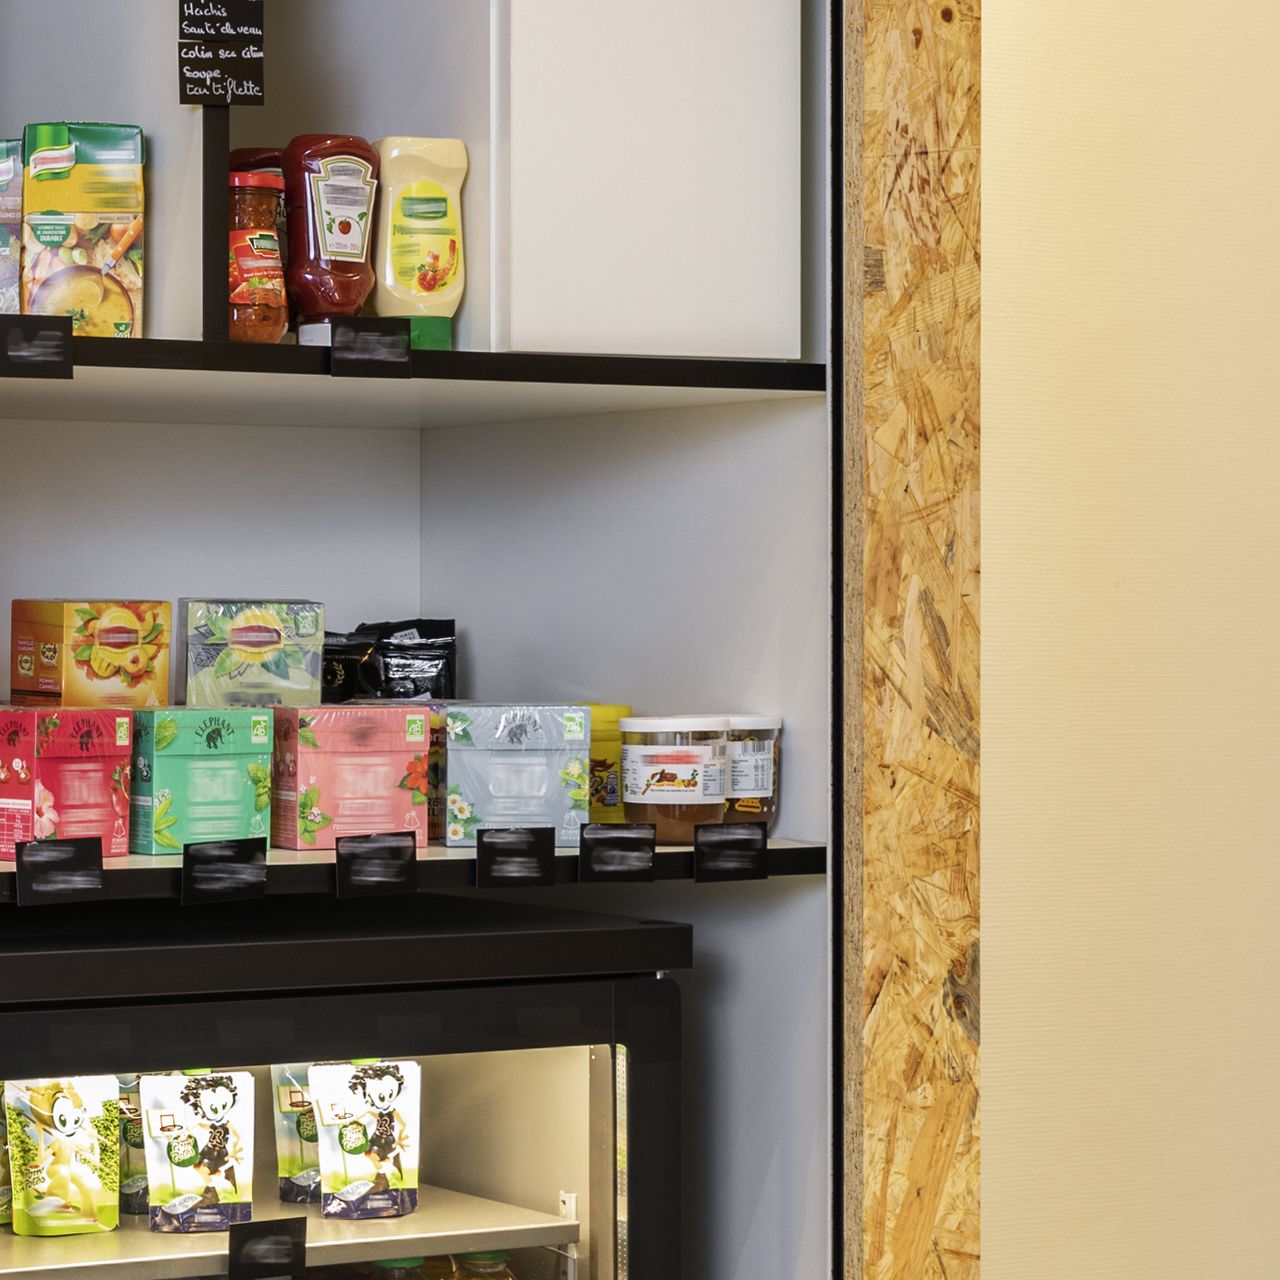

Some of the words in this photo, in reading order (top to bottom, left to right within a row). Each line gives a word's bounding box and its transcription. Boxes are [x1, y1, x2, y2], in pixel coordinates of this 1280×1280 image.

[184, 2, 228, 17] Hachis
[237, 26, 263, 36] veau
[181, 45, 213, 59] colin
[183, 65, 222, 86] Soupe
[0, 719, 29, 738] ELEPHANT
[70, 717, 104, 738] ELEPHANT
[194, 716, 236, 738] ELEPHANT
